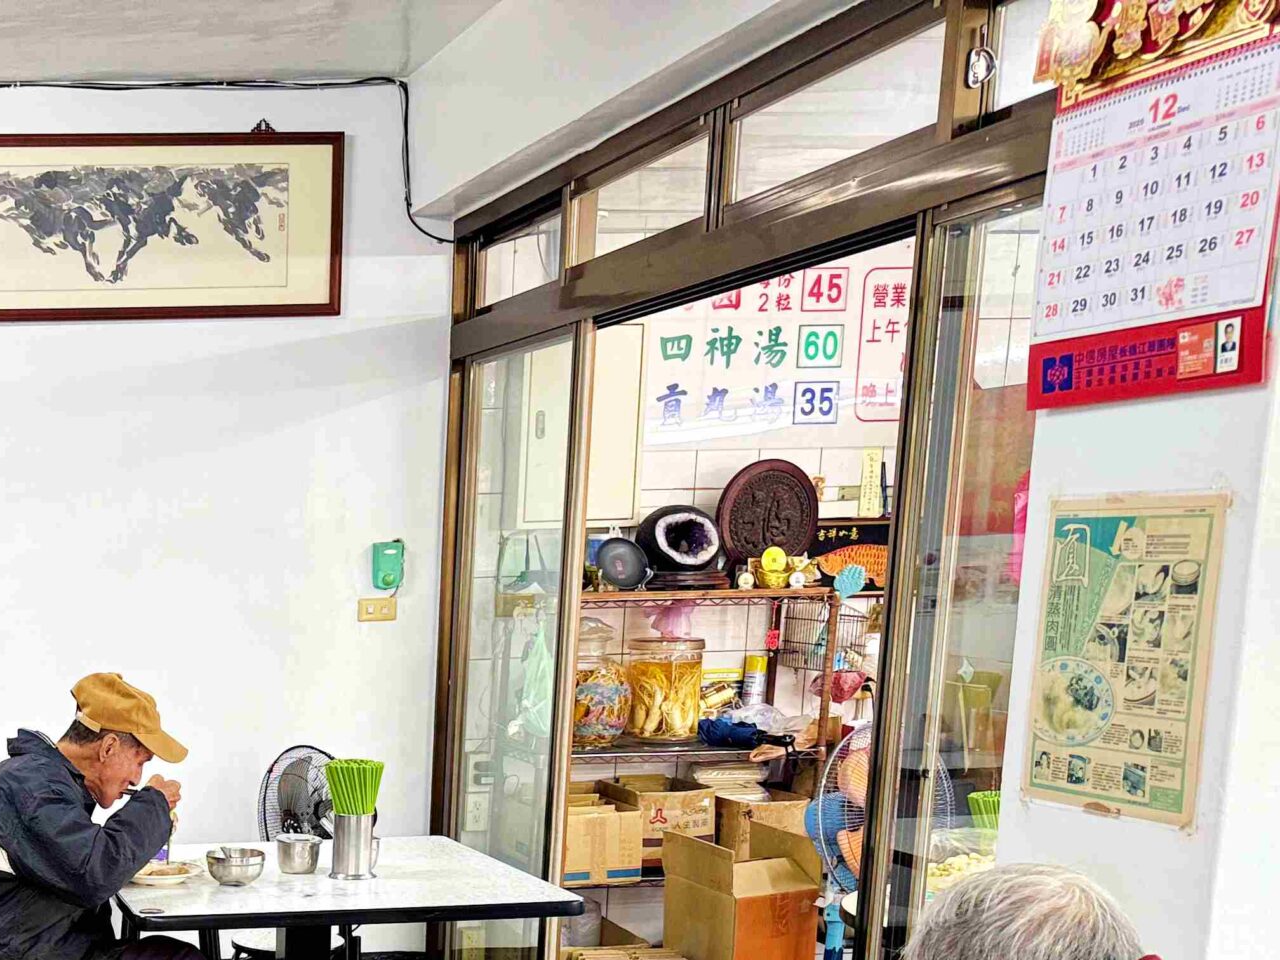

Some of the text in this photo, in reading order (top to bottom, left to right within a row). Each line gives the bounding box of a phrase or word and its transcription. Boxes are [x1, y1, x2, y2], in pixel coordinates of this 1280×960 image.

[1148, 93, 1179, 123] 12
[1091, 164, 1098, 178] 1
[1119, 155, 1127, 170] 2
[1150, 146, 1159, 161] 3
[1183, 135, 1192, 151] 4
[1218, 126, 1228, 141] 5
[1255, 114, 1266, 130] 6
[1059, 152, 1265, 220] 7 8 9 10 11 12 13
[1051, 191, 1260, 253] 14 15 16 17 18 19 20
[1048, 228, 1254, 286] 21 22 23 24 25 26 27
[758, 293, 792, 312] 2粒
[808, 274, 842, 303] 45
[873, 283, 907, 308] 營業
[1045, 286, 1146, 318] 28 29 30 31
[659, 325, 838, 369] 四神湯 60
[866, 319, 910, 343] 上午
[656, 382, 833, 425] 貢丸湯 35
